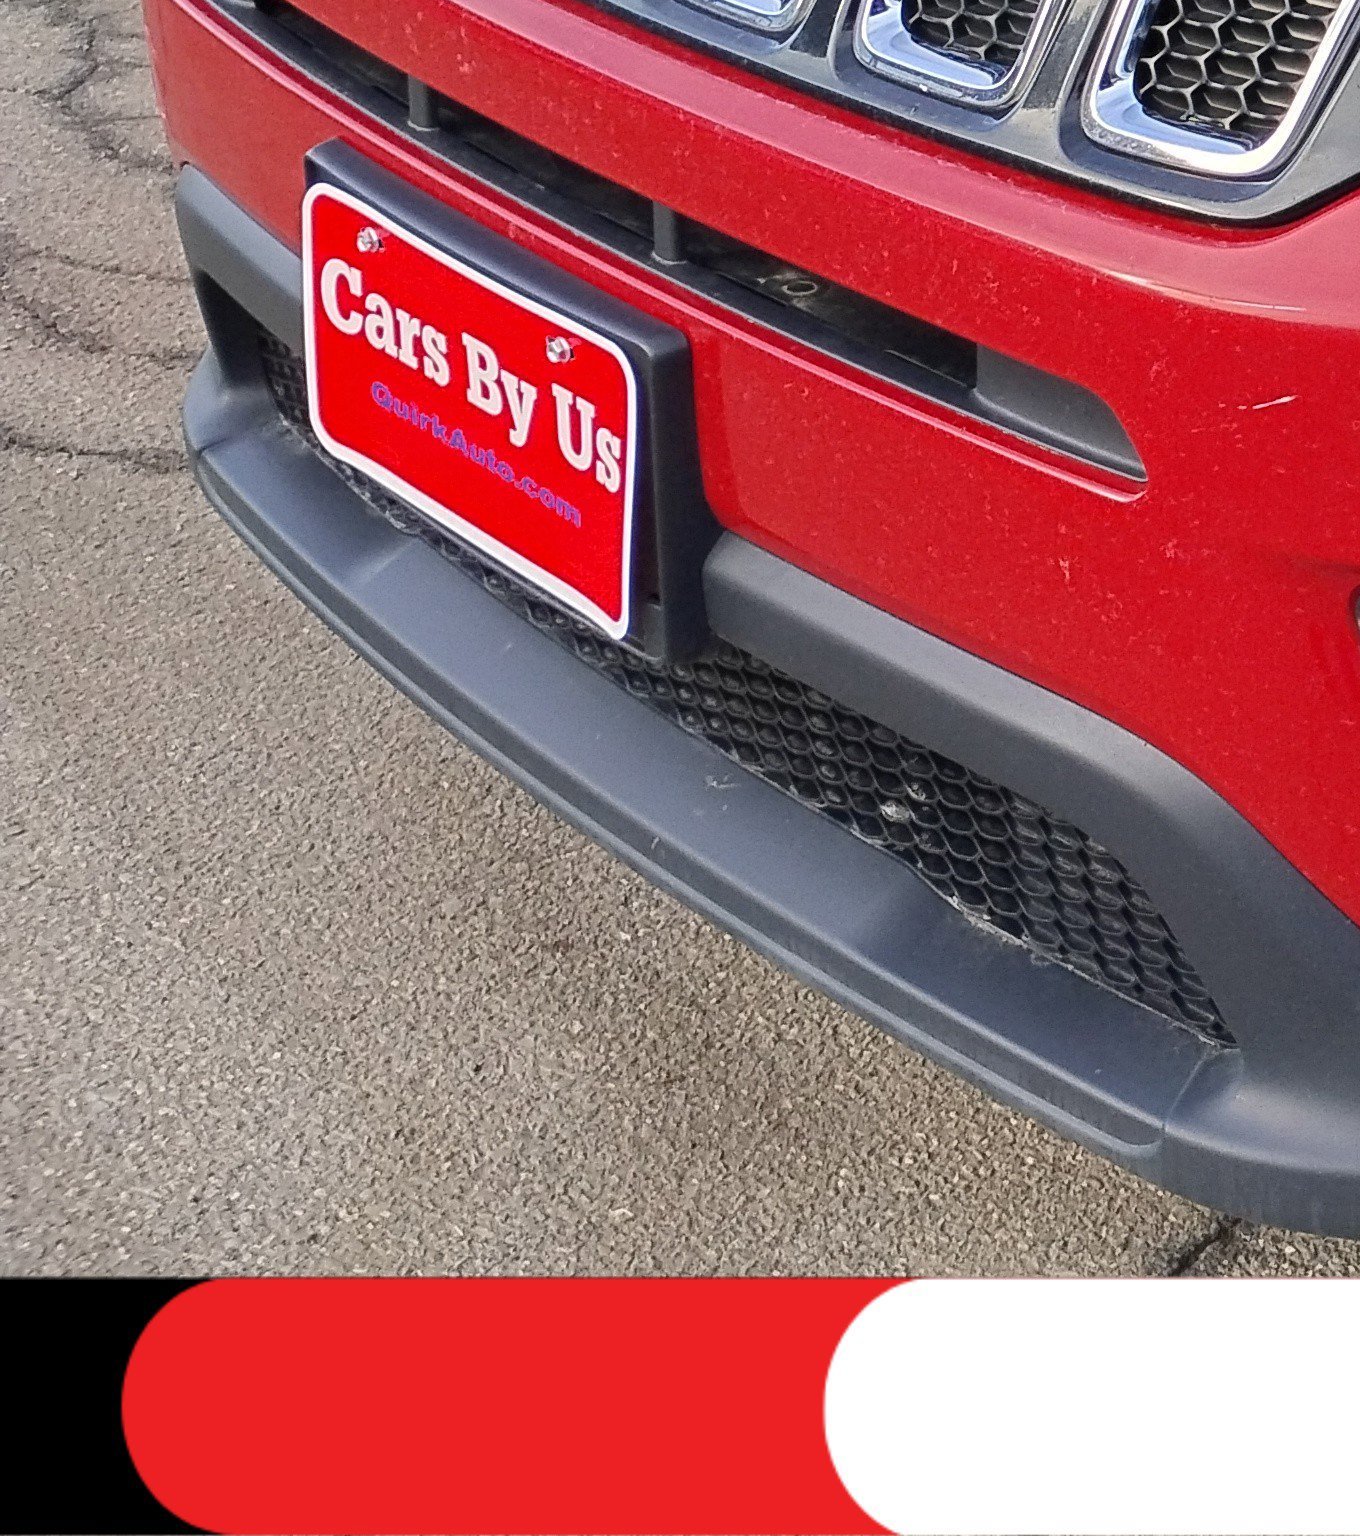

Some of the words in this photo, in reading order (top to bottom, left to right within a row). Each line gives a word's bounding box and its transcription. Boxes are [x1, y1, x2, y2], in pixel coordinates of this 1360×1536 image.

[320, 257, 452, 387] Cars
[461, 331, 538, 448] By
[551, 382, 622, 494] Us
[370, 380, 583, 529] QuirkAuto.com
